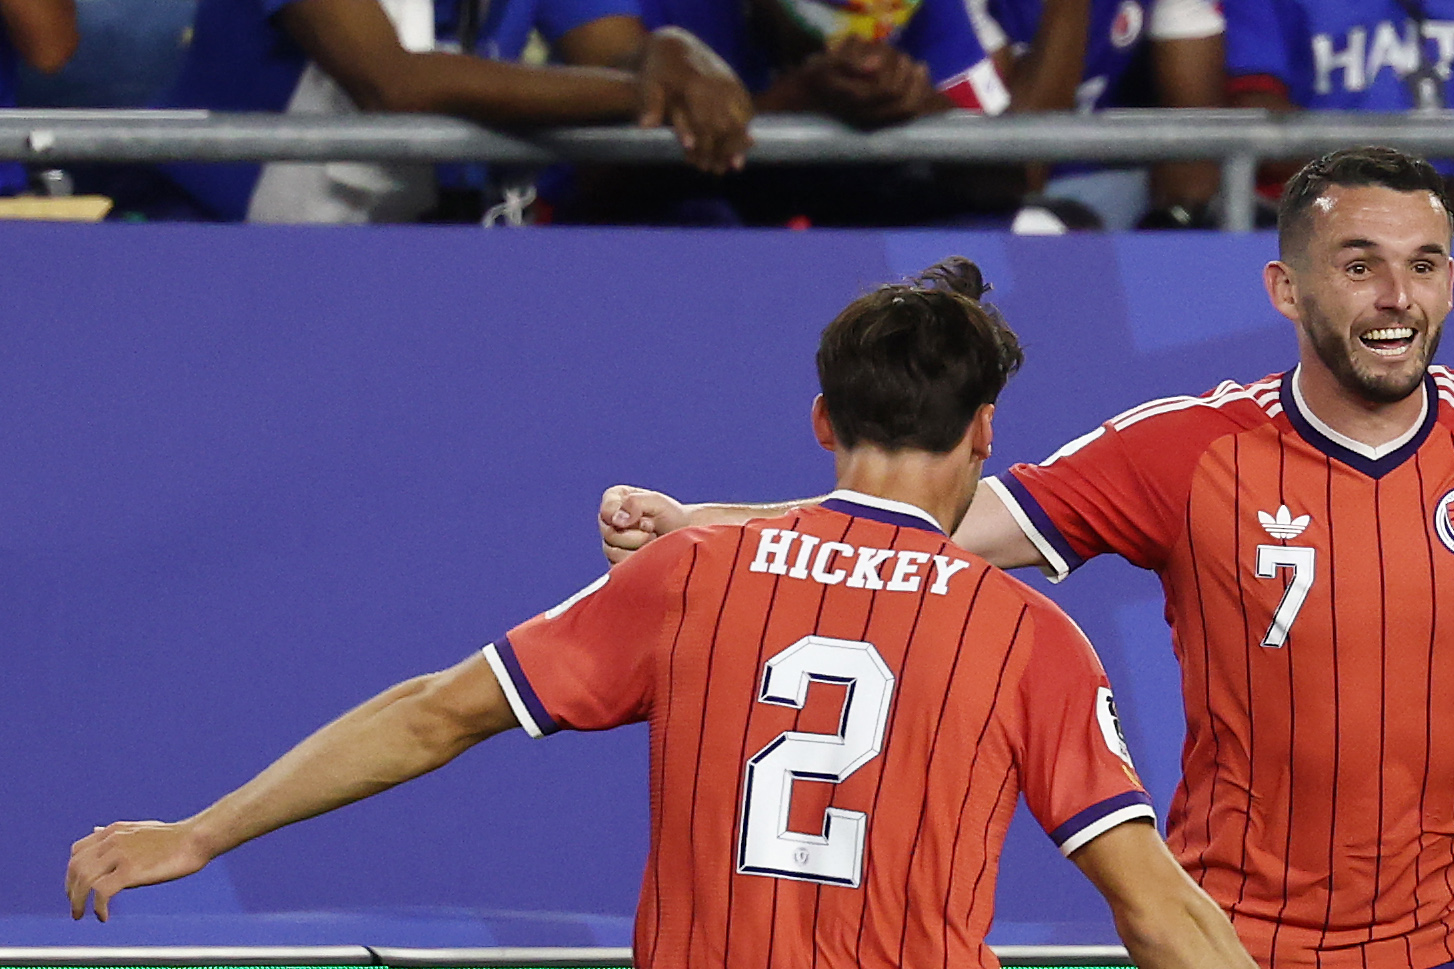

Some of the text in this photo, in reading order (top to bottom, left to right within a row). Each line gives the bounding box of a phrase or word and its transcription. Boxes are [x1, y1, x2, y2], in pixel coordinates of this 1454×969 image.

[750, 528, 970, 595] HICKEY
[1255, 544, 1315, 648] 7
[737, 635, 895, 889] 2
